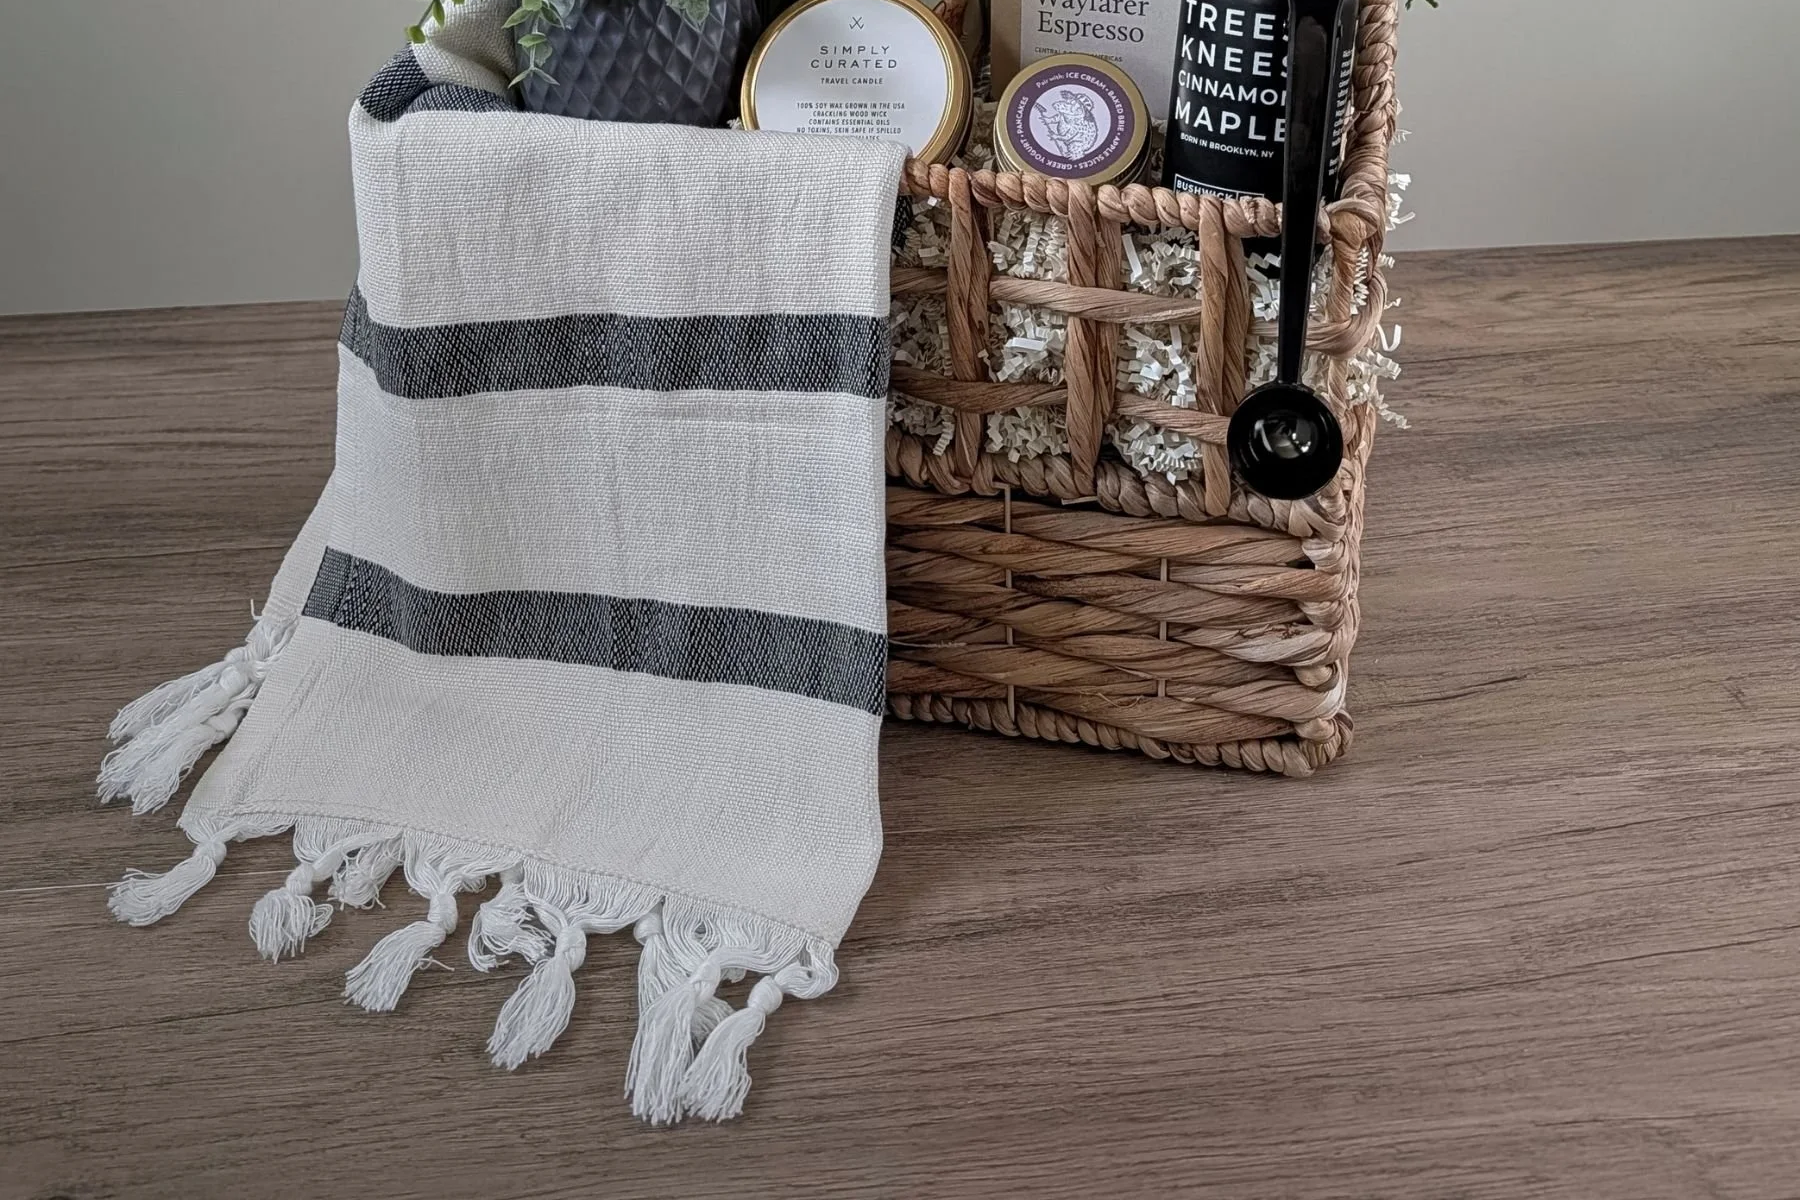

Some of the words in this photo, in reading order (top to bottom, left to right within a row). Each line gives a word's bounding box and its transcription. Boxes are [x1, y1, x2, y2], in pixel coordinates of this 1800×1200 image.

[1038, 10, 1144, 43] Espresso
[819, 45, 890, 55] SIMPLY
[810, 59, 898, 69] CURATED
[820, 77, 849, 85] TRAVEL
[852, 77, 883, 85] CANDLE
[1035, 79, 1049, 89] Pair
[1065, 71, 1080, 79] ICE
[1080, 73, 1106, 90] CREAM
[797, 102, 813, 110] 100%
[815, 102, 827, 110] SOY
[829, 102, 843, 110] WAX
[844, 102, 868, 110] GROWN
[869, 102, 877, 110] IN
[879, 102, 890, 110] THE
[813, 110, 847, 118] CRACKLING
[849, 110, 869, 118] WOOD
[1107, 90, 1124, 114] BAKED
[1117, 115, 1125, 132] BRIE
[808, 118, 840, 126] CONTAINS
[841, 118, 874, 126] ESSENTIAL
[875, 118, 890, 126] OILS
[1015, 96, 1029, 134] PANCAKES
[1174, 96, 1286, 143] MAPLE
[1020, 138, 1046, 163] YOGURT
[1105, 136, 1121, 157] APPLE
[1180, 132, 1198, 145] BORN
[1199, 138, 1208, 147] IN
[1261, 149, 1275, 158] NY
[1046, 161, 1073, 170] GREEK
[1079, 156, 1105, 169] SLICES
